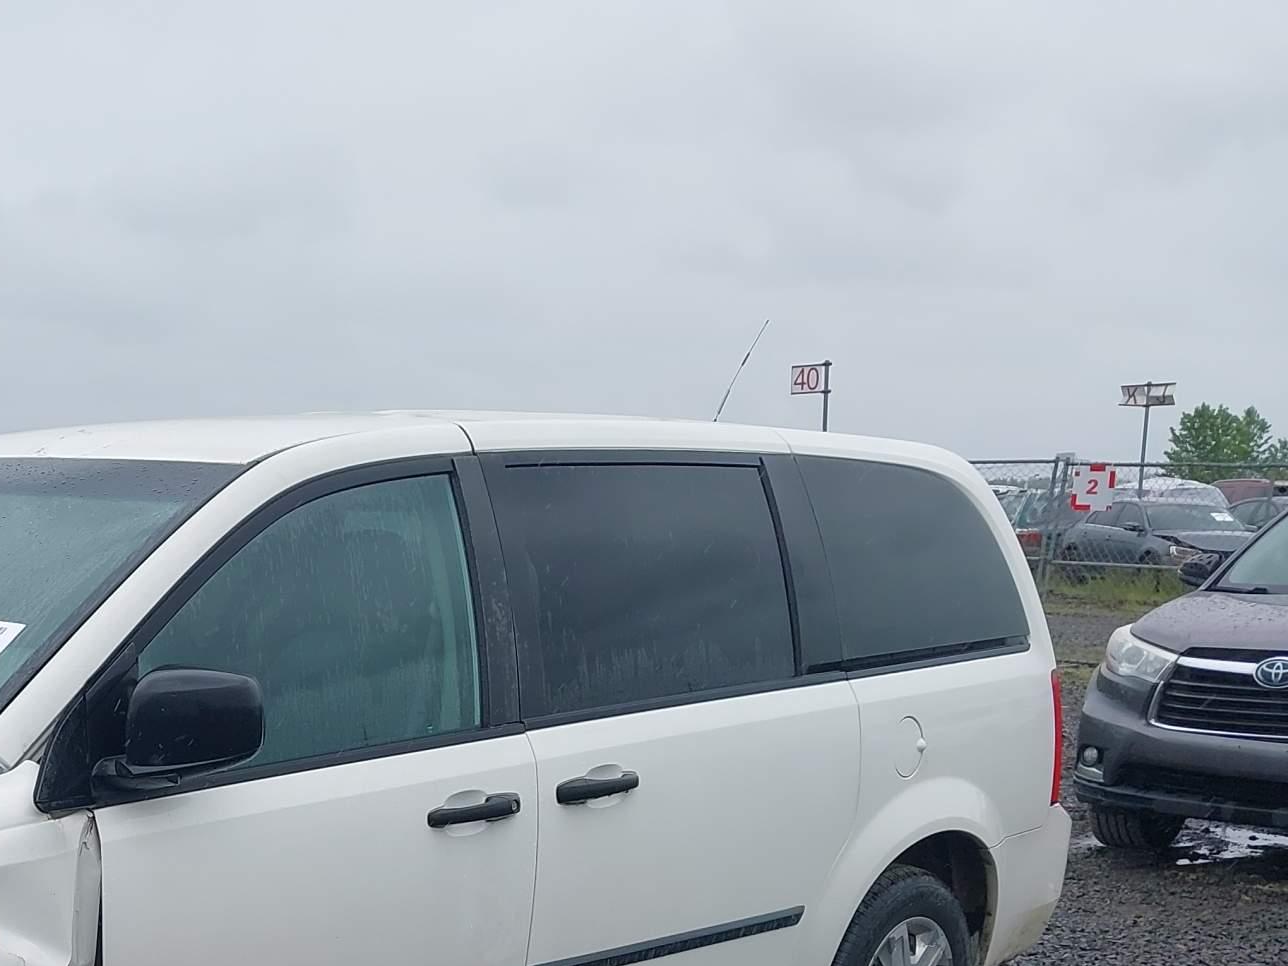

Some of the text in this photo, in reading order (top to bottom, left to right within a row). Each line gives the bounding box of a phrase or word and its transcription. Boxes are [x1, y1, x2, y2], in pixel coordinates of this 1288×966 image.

[793, 367, 819, 391] 40
[1125, 387, 1138, 405] K
[1085, 479, 1099, 495] 2
